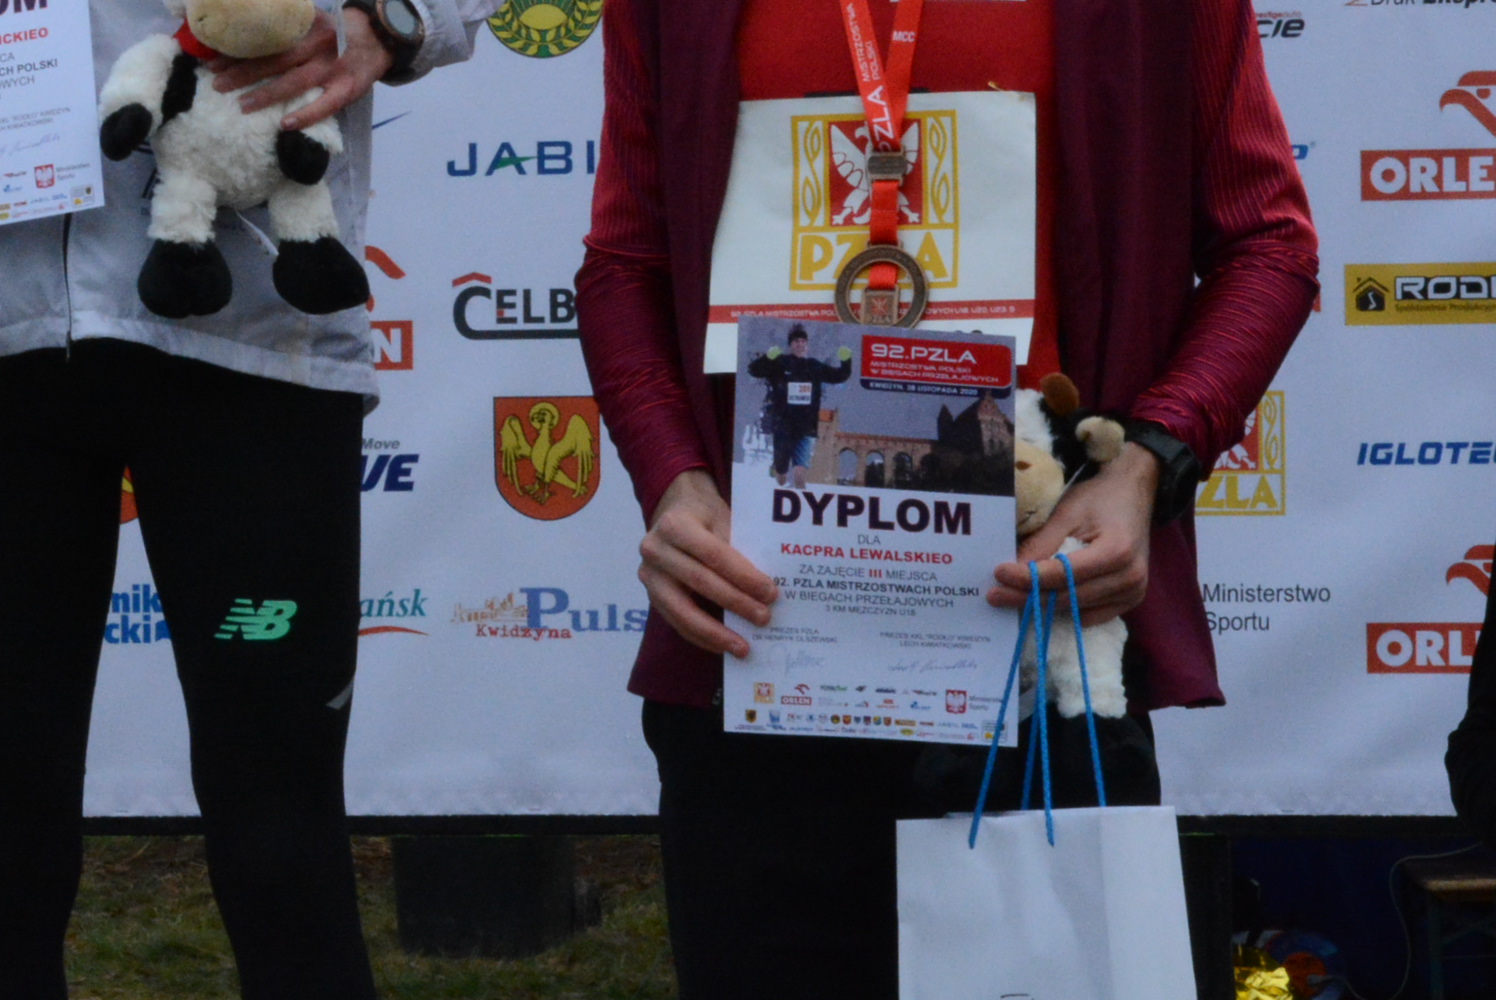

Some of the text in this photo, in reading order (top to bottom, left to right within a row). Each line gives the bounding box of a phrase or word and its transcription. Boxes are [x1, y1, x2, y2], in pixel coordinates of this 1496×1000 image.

[17, 58, 59, 74] POLSKI
[870, 343, 977, 365] 92.PZLA
[771, 488, 972, 536] DYPLOM
[857, 534, 882, 545] DLA
[780, 543, 953, 564] KACPRA LEWALSKIEO
[868, 568, 883, 579] III
[885, 569, 938, 582] MIEJSCA
[793, 578, 825, 589] PZLA
[826, 580, 932, 595] MISTRZOSTWACH
[934, 586, 980, 597] POLSKI
[1203, 583, 1332, 603] Ministerstwo
[799, 591, 853, 604] BIEGACH
[475, 623, 573, 642] Kwidzyna
